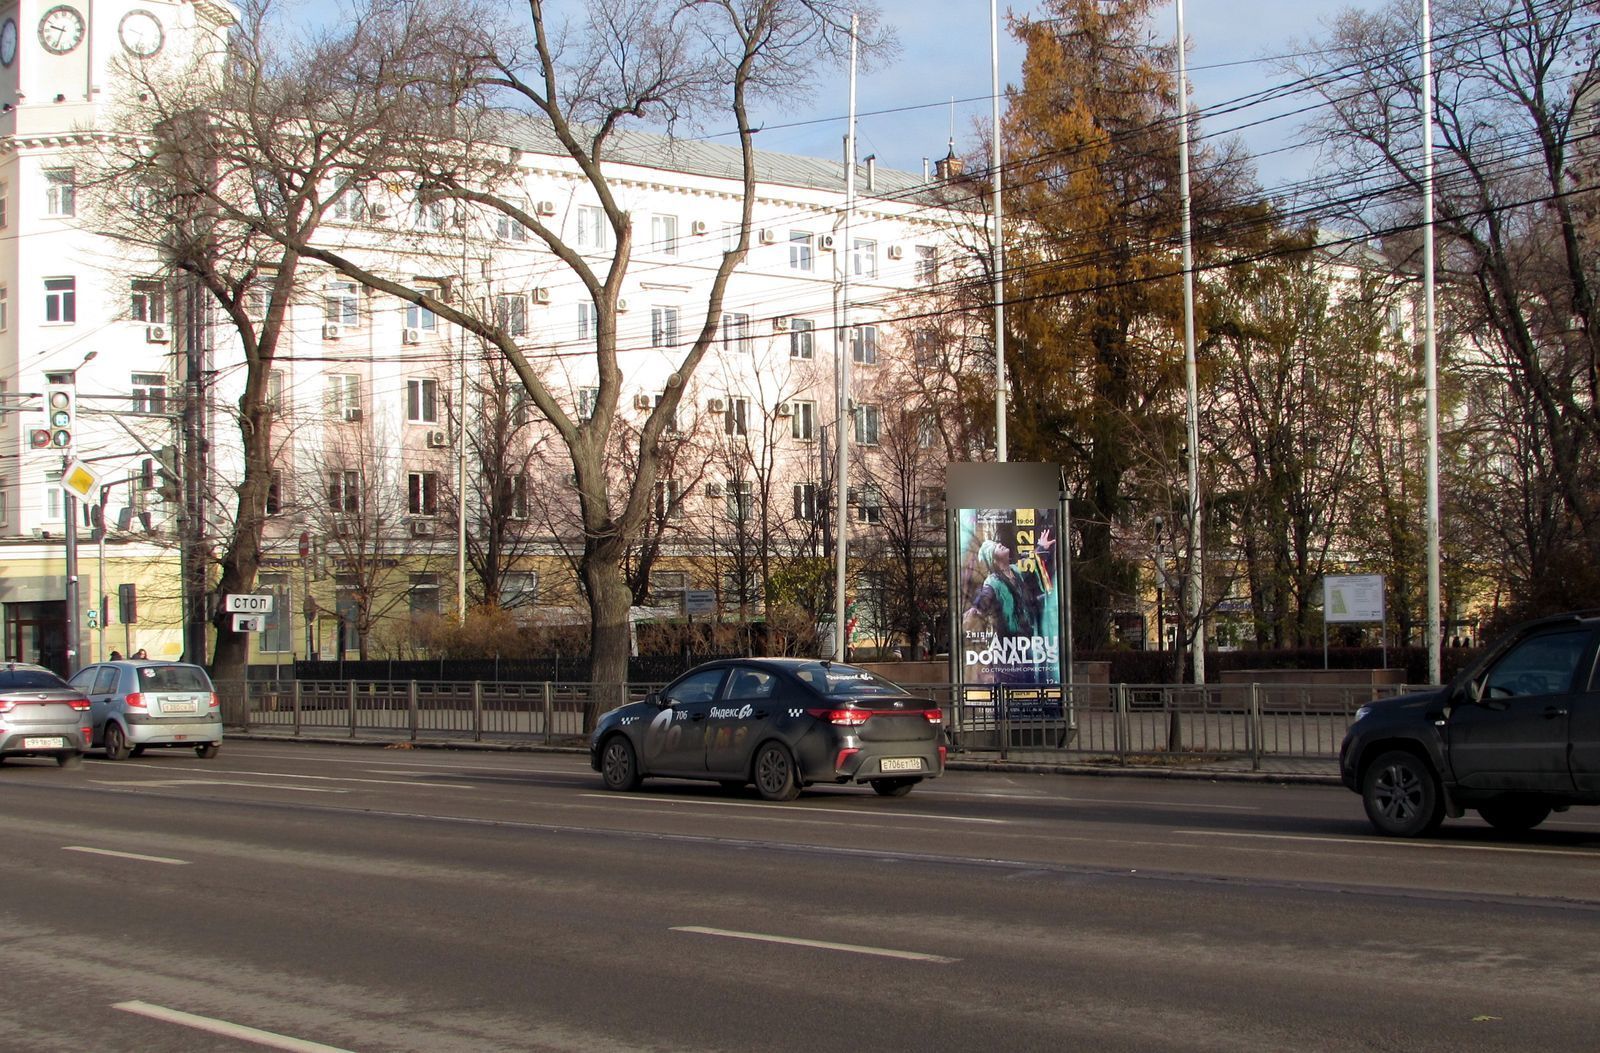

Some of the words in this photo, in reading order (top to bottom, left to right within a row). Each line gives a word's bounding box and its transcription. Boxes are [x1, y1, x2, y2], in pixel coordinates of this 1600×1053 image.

[234, 598, 267, 609] СТОП
[965, 648, 1059, 665] DONALDS
[676, 710, 688, 720] 706
[709, 706, 738, 719] Яндекс
[738, 704, 753, 719] Go
